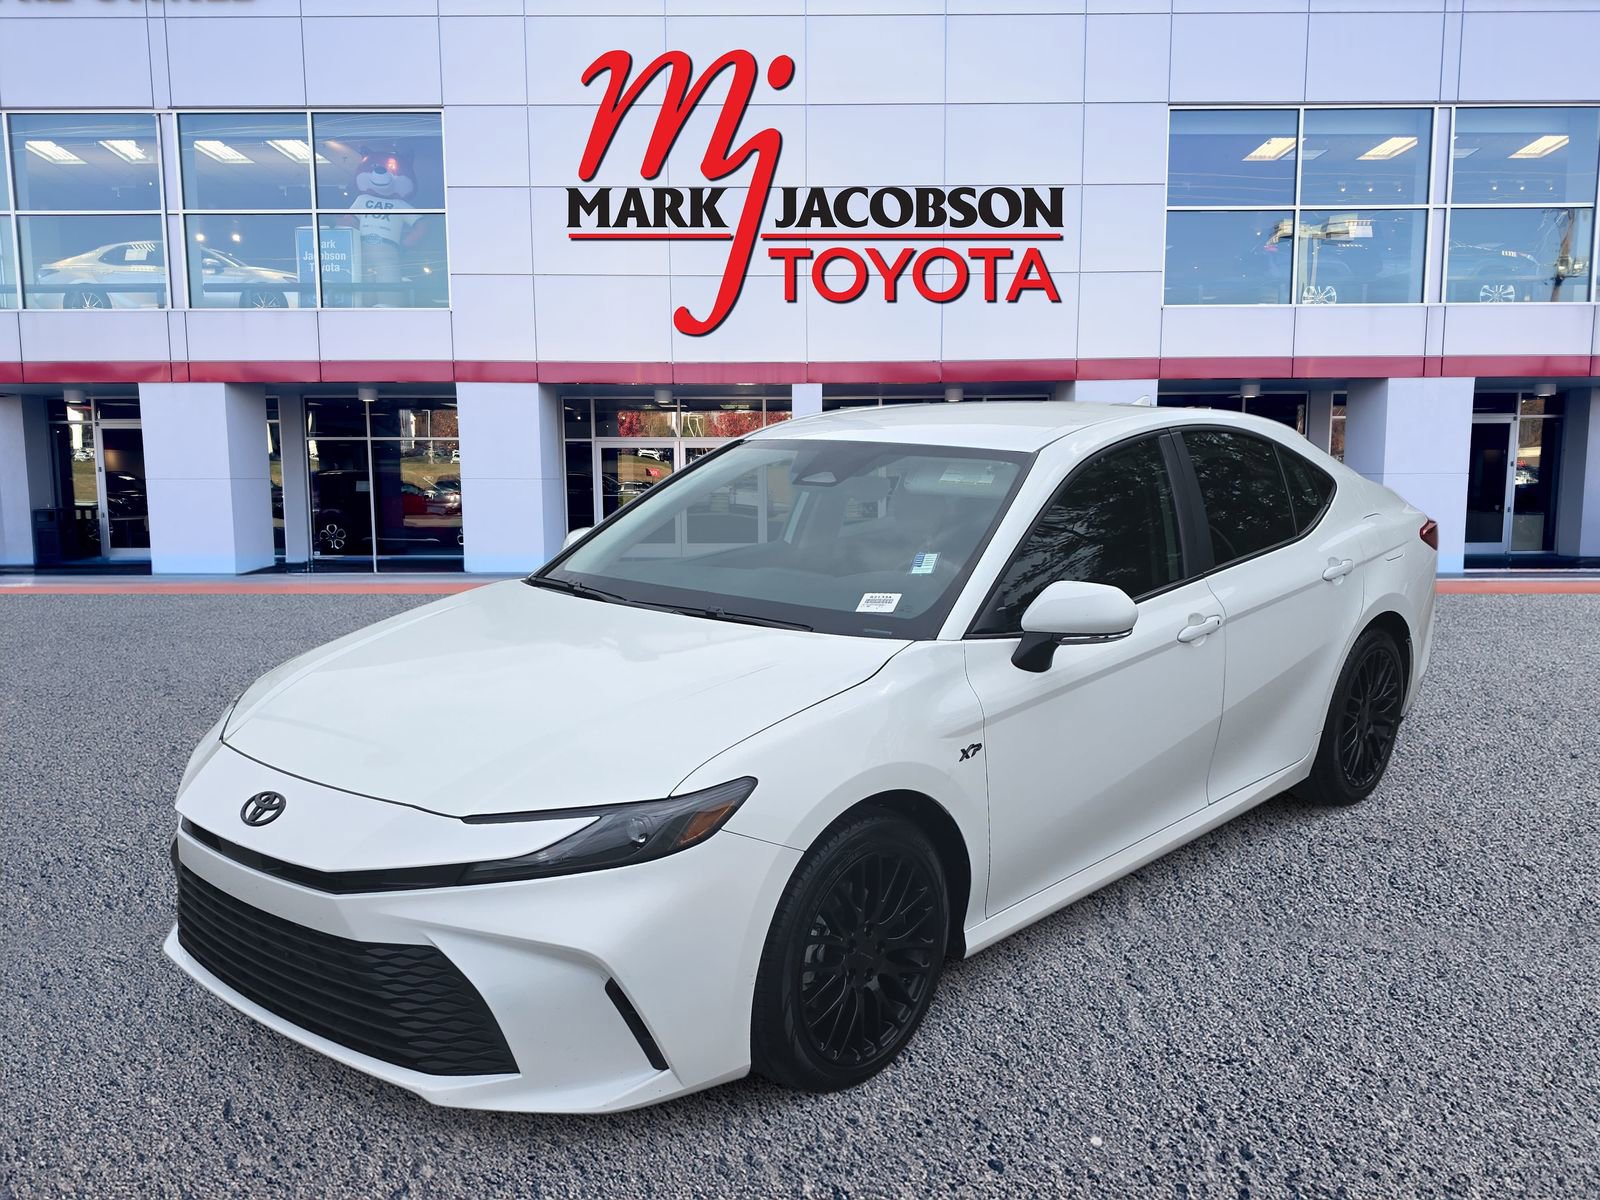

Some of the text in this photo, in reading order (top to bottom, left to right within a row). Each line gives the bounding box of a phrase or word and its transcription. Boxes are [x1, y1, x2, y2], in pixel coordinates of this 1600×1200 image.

[365, 199, 394, 209] CAR
[565, 186, 1065, 229] MARK JACOBSON
[316, 240, 336, 249] ark
[768, 247, 1062, 303] TOYOTA
